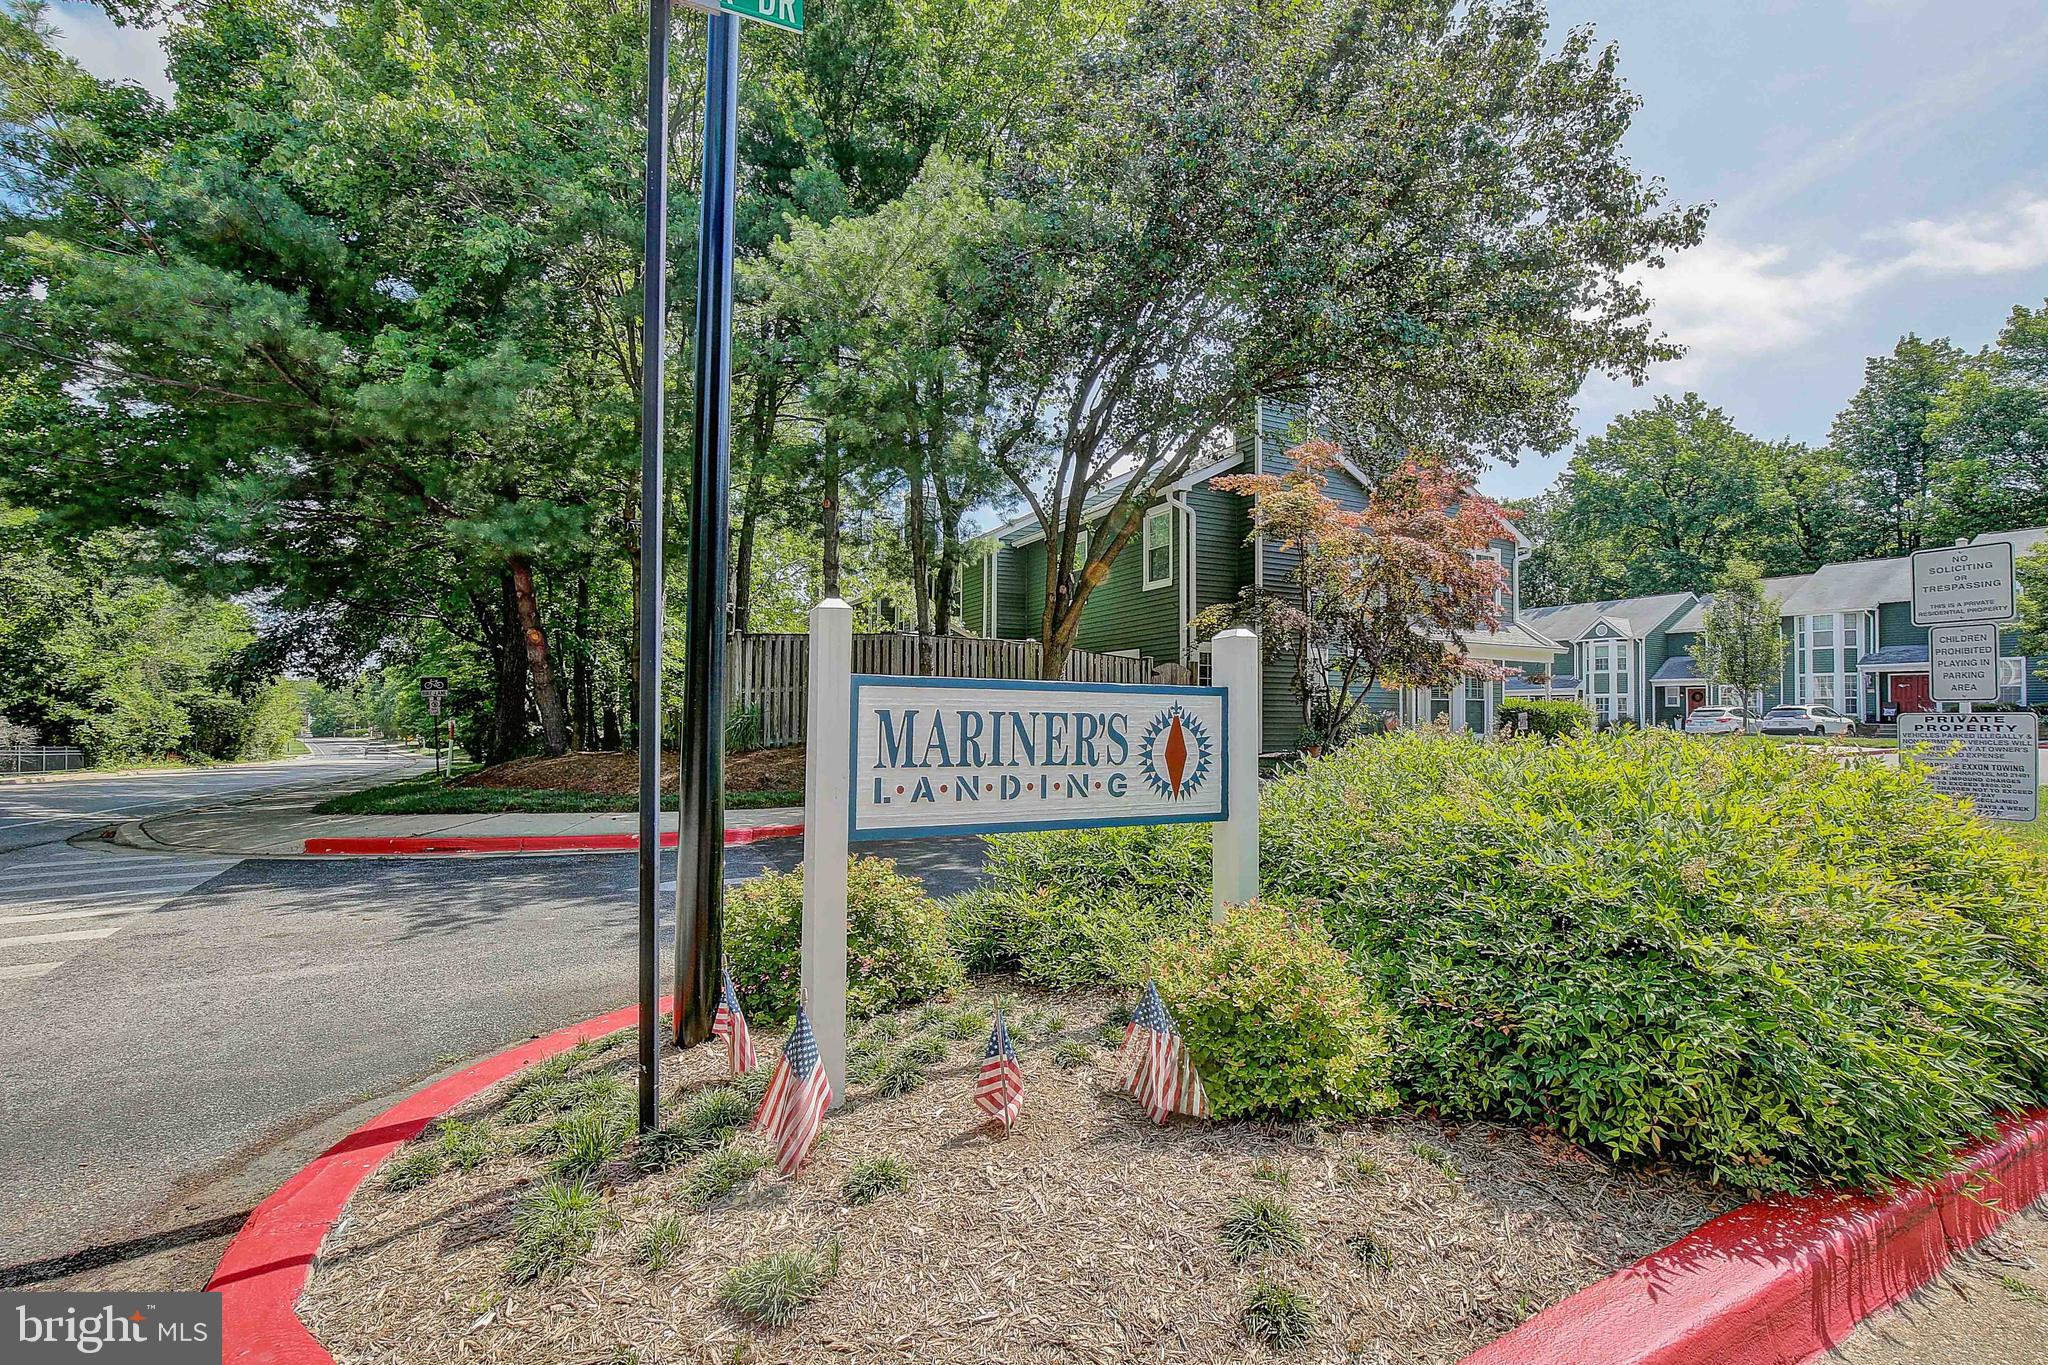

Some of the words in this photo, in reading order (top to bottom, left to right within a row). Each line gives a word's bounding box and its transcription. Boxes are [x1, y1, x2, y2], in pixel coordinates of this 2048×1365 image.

[758, 0, 795, 23] DR
[1952, 555, 1968, 563] NO
[1928, 562, 1993, 575] SOLICITING
[1922, 579, 2002, 593] TRESPASSING
[1963, 599, 1995, 607] PRIVATE
[1918, 609, 1965, 617] RESIDENTIAL
[1967, 605, 2008, 613] PROPERTY
[1939, 634, 1987, 643] CHILDREN
[1935, 646, 1992, 655] PROHIBITED
[1938, 659, 1978, 667] PLAYING
[1943, 671, 1985, 679] PARKING
[1914, 724, 2018, 732] PROPERTY
[873, 709, 1129, 768] MARINER'S
[1962, 763, 1989, 771] EXXON
[1992, 764, 2025, 772] TOWING
